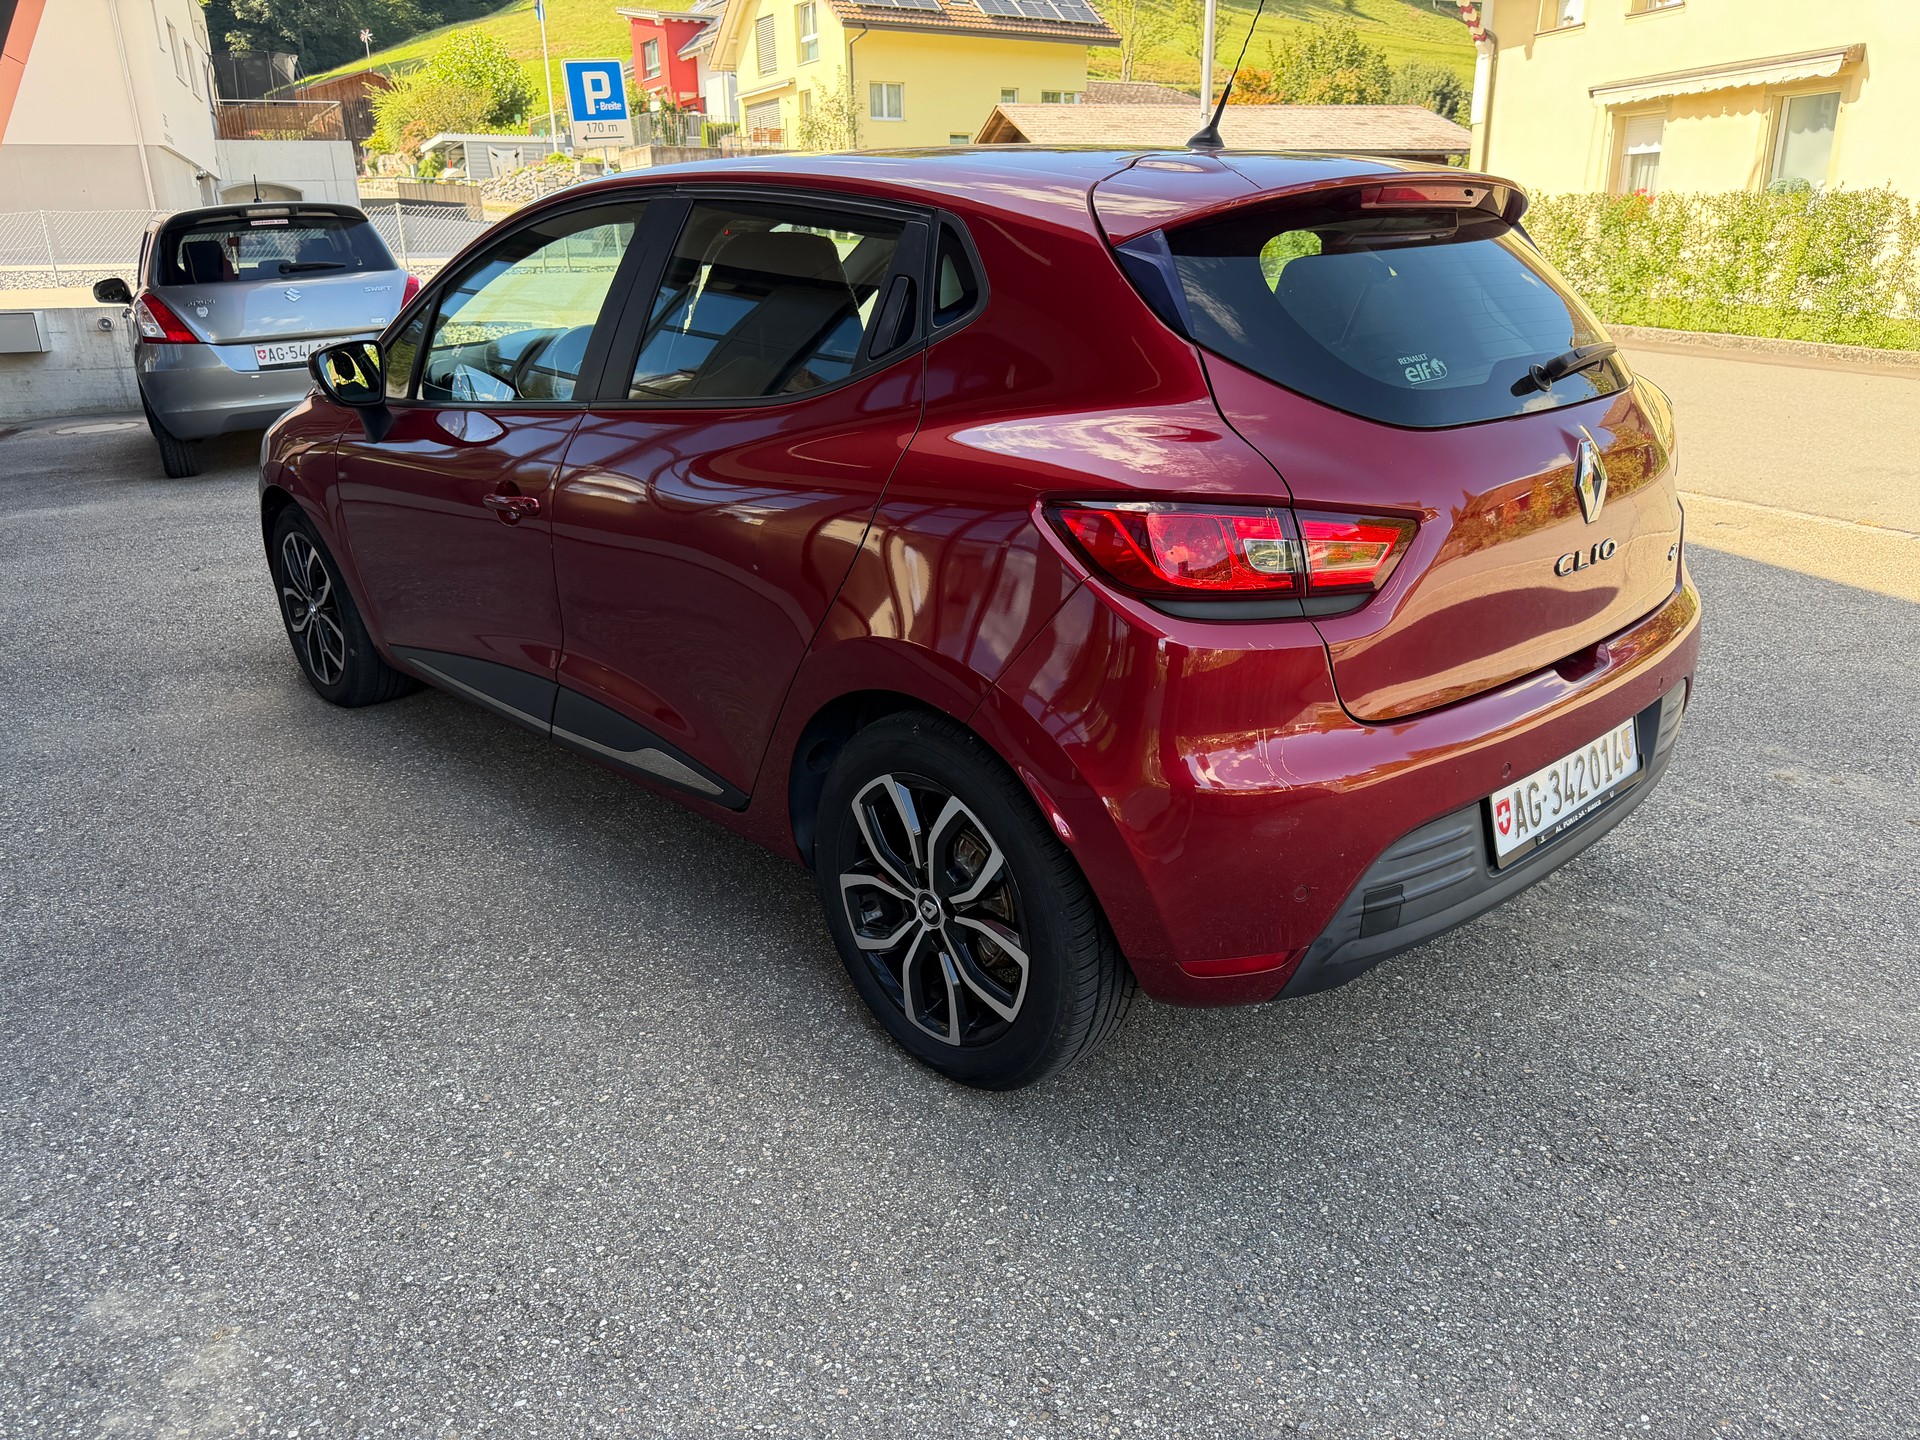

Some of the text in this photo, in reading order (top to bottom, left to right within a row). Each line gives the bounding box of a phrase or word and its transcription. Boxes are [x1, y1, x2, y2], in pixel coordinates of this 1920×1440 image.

[581, 71, 611, 115] P
[586, 122, 618, 133] 170 m
[364, 285, 392, 293] SWIFT
[1397, 353, 1428, 365] RENAULT
[1405, 362, 1431, 382] elf
[1554, 537, 1618, 577] CLIO
